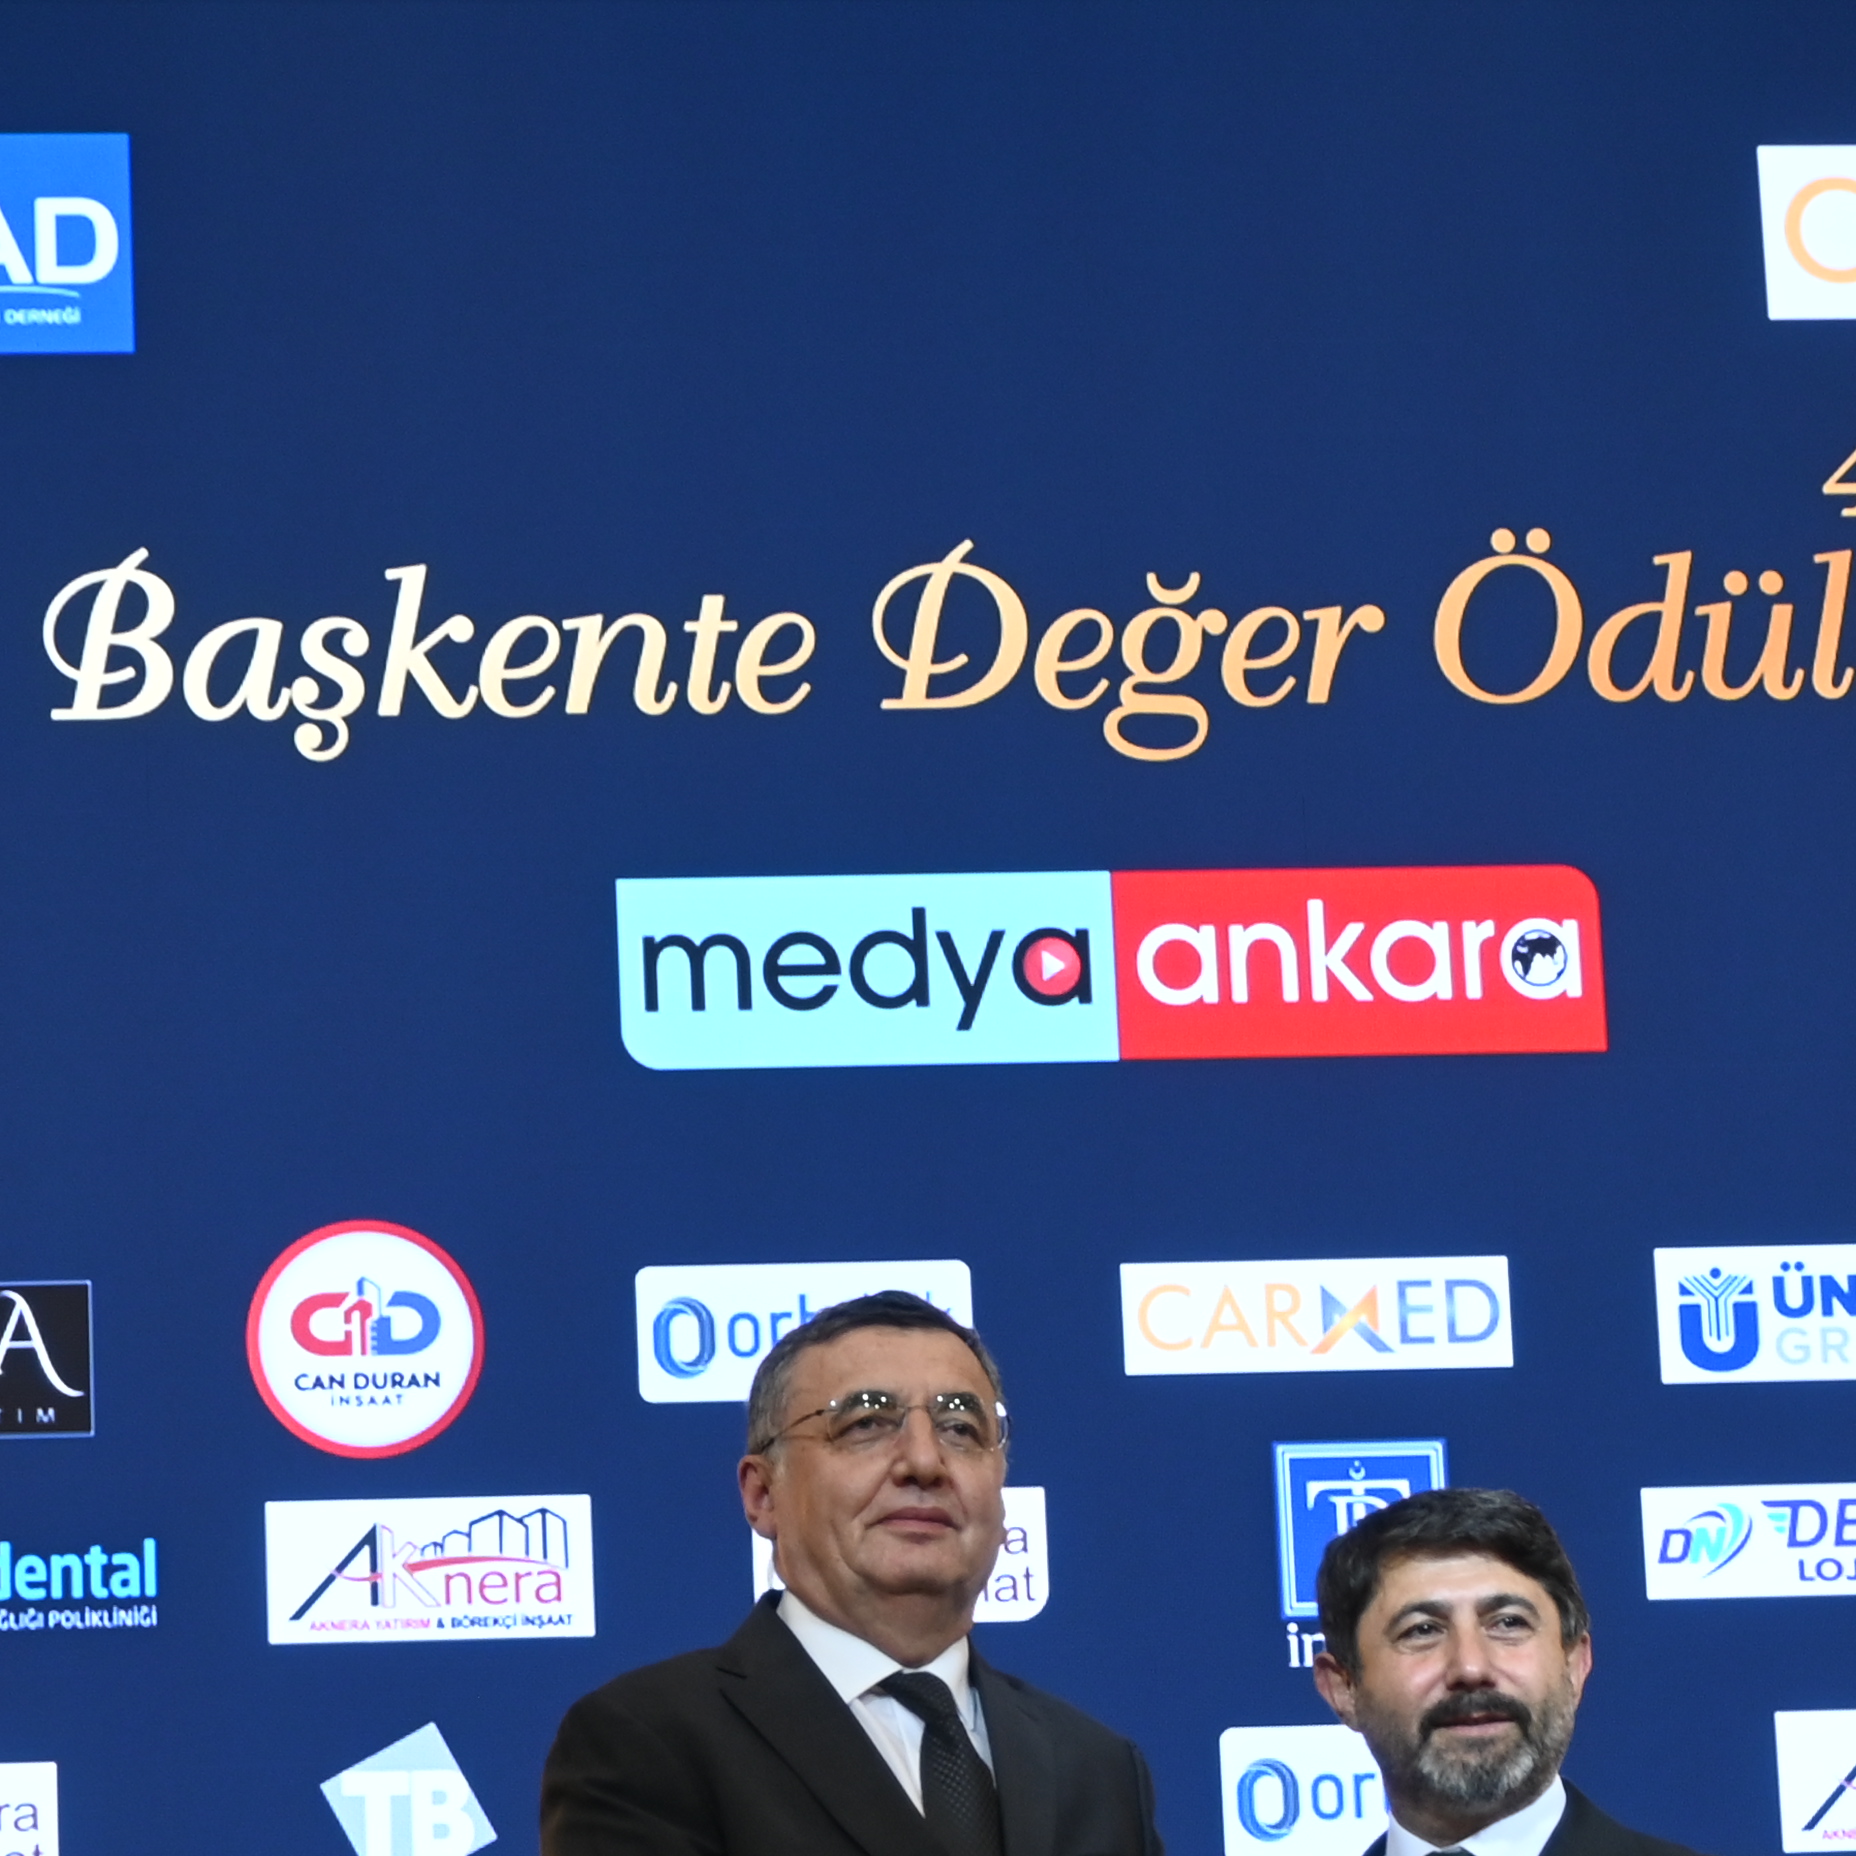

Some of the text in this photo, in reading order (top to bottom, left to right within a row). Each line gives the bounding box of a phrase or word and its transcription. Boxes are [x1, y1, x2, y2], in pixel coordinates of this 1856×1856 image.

[4, 305, 81, 325] DERNEĞİ
[42, 545, 817, 762] Başkente
[872, 538, 1386, 761] Değer
[642, 898, 1584, 1032] medya ankara
[1138, 1279, 1500, 1354] CARMED
[294, 1371, 441, 1391] CAN DURAN
[47, 1604, 158, 1630] POLİKLİNİĞİ
[309, 1619, 371, 1632] AKNERA
[436, 1617, 445, 1629] &
